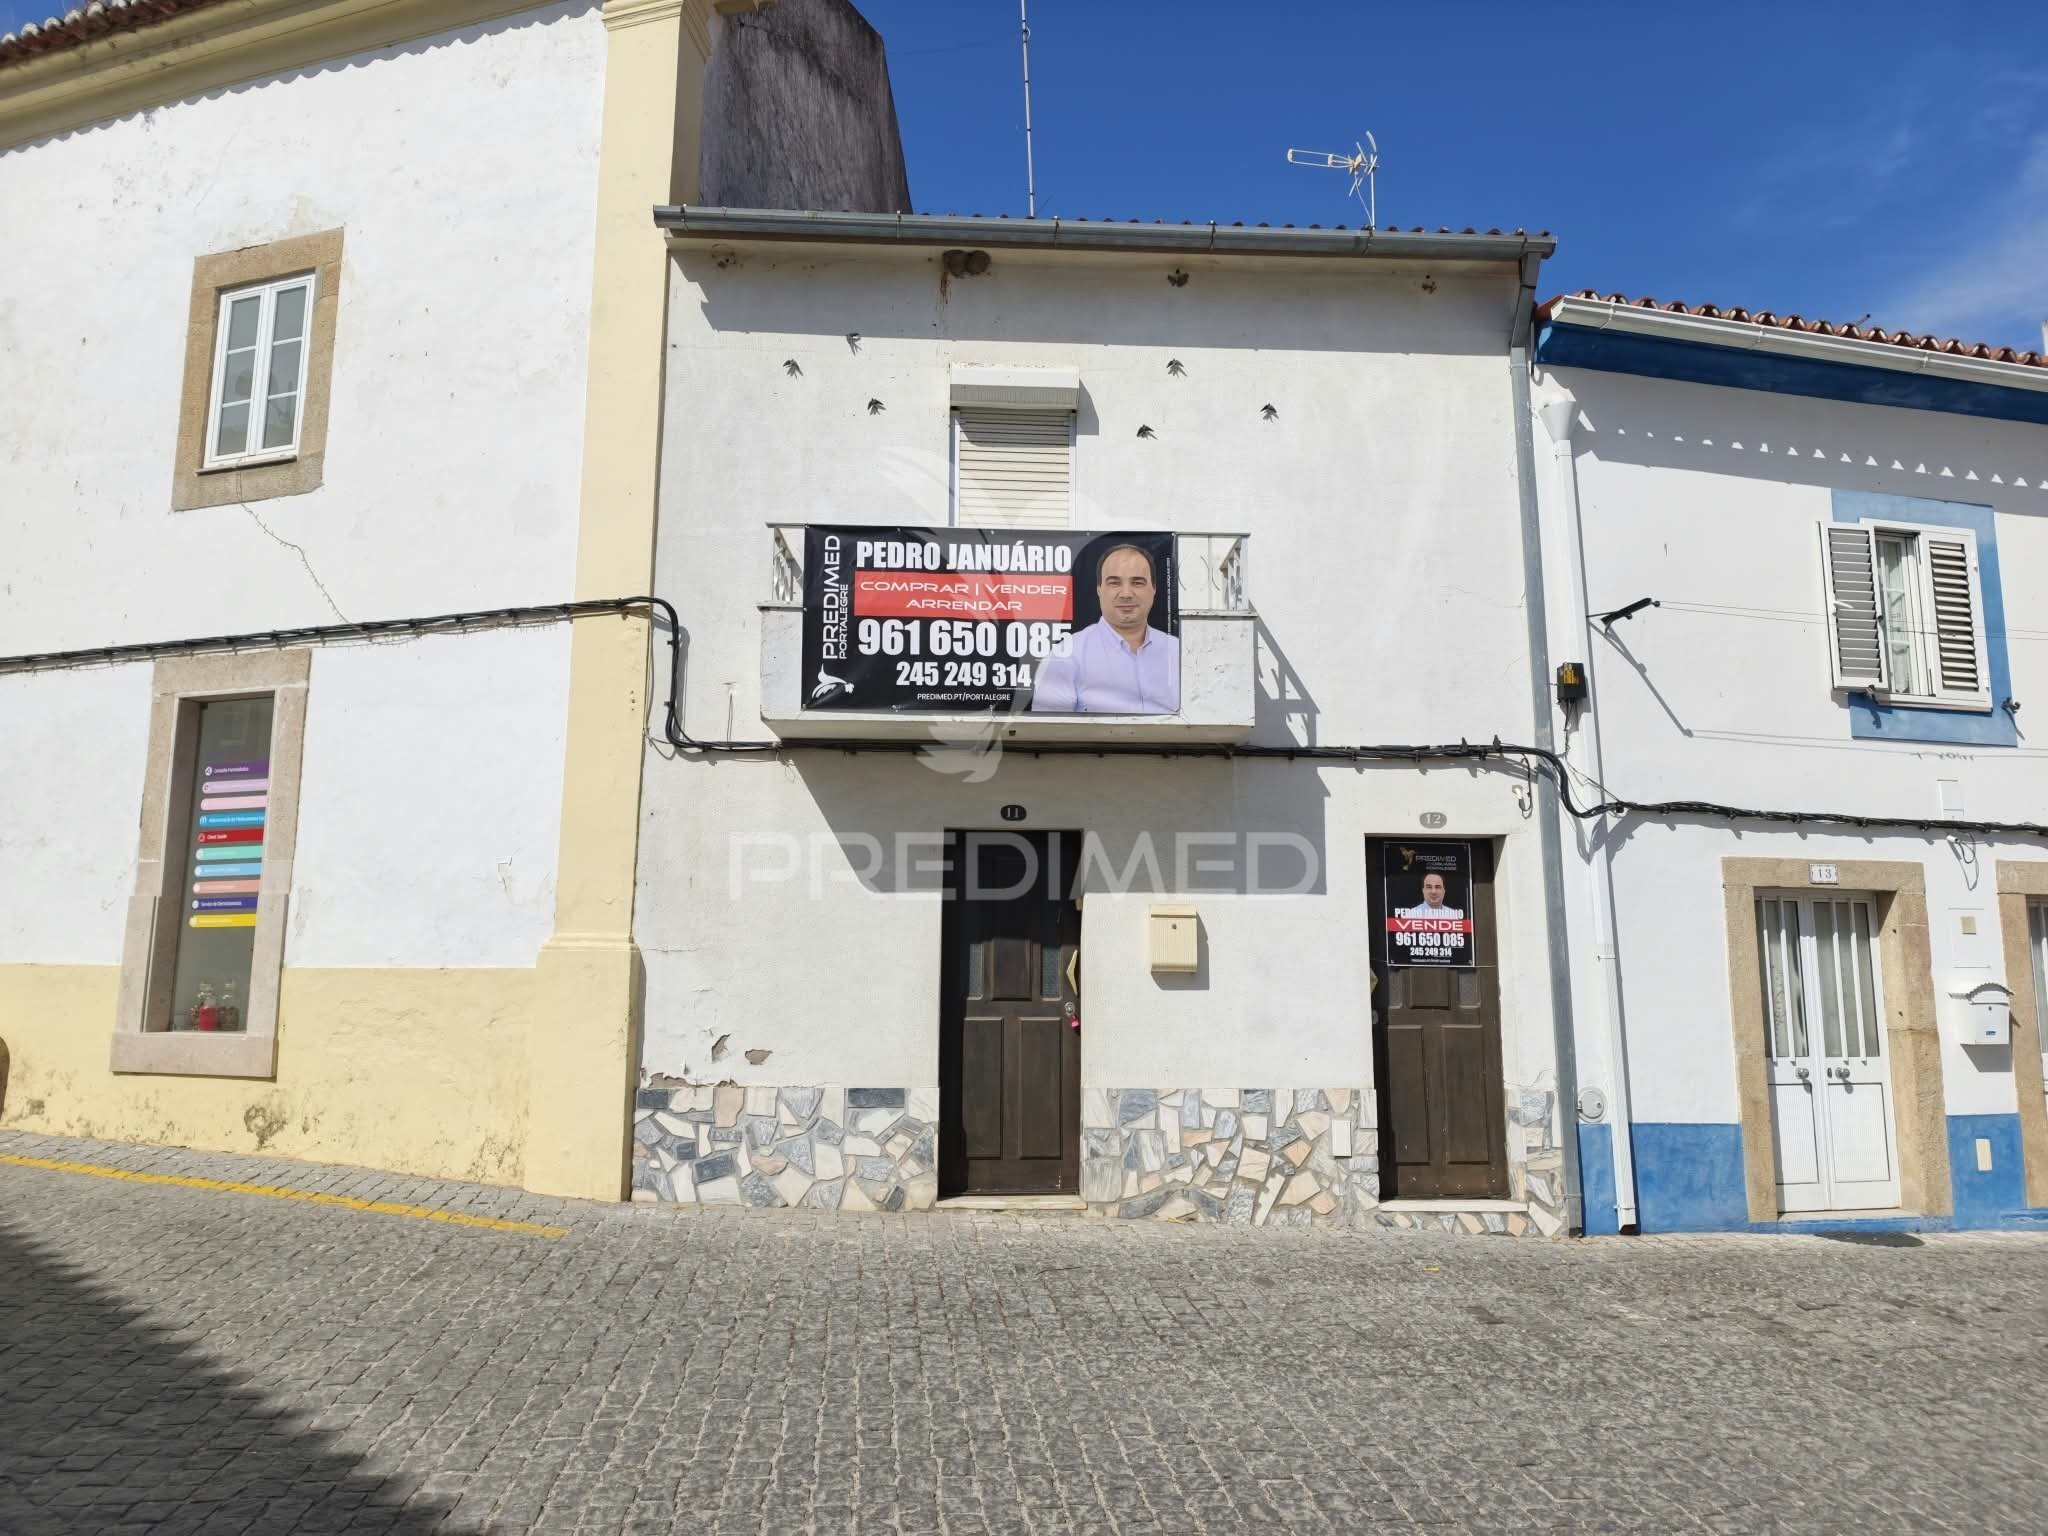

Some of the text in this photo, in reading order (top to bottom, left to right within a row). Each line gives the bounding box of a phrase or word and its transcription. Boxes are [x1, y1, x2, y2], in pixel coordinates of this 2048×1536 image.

[856, 540, 1072, 572] PEDRO JANUÁRIO
[860, 581, 969, 594] COMPRAR
[985, 584, 1068, 595] VENDER
[822, 535, 840, 659] PREDIMED
[905, 599, 1023, 611] ARRENDAR
[839, 584, 849, 659] PORTALEGRE
[858, 618, 1074, 658] 961 650 085
[895, 661, 1032, 687] 245 249 314
[917, 692, 1011, 701] PREDIMED.PT/PORTALEGRE
[1006, 807, 1019, 818] 11
[1425, 814, 1442, 825] 12
[1818, 868, 1832, 879] 13
[1396, 920, 1464, 931] VENDE
[1395, 932, 1464, 947] 961 650 085
